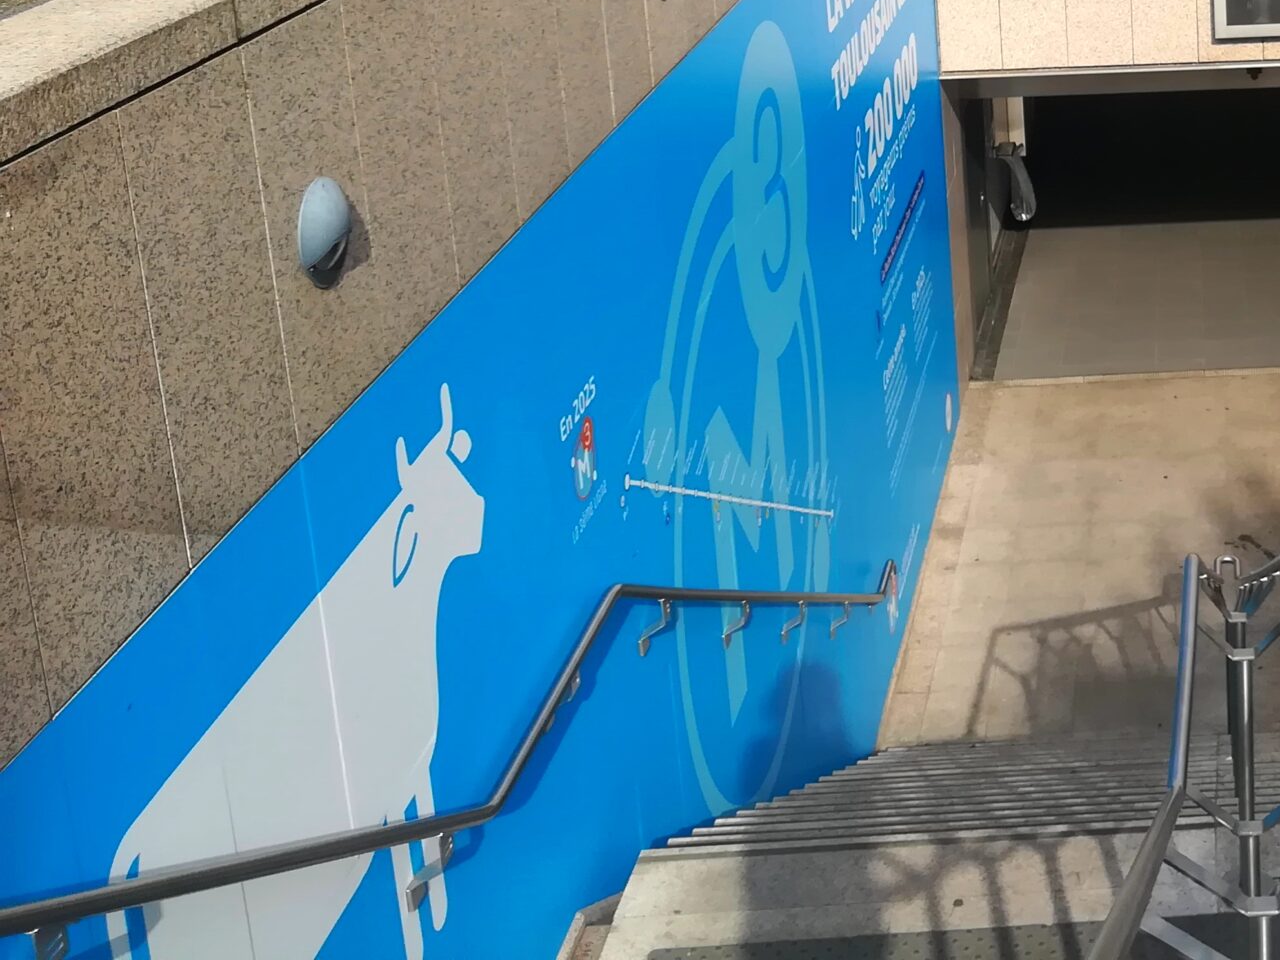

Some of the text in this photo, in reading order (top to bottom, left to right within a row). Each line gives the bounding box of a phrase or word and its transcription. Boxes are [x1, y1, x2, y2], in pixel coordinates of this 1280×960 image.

[864, 32, 919, 178] 200 000
[559, 375, 596, 442] En 2025
